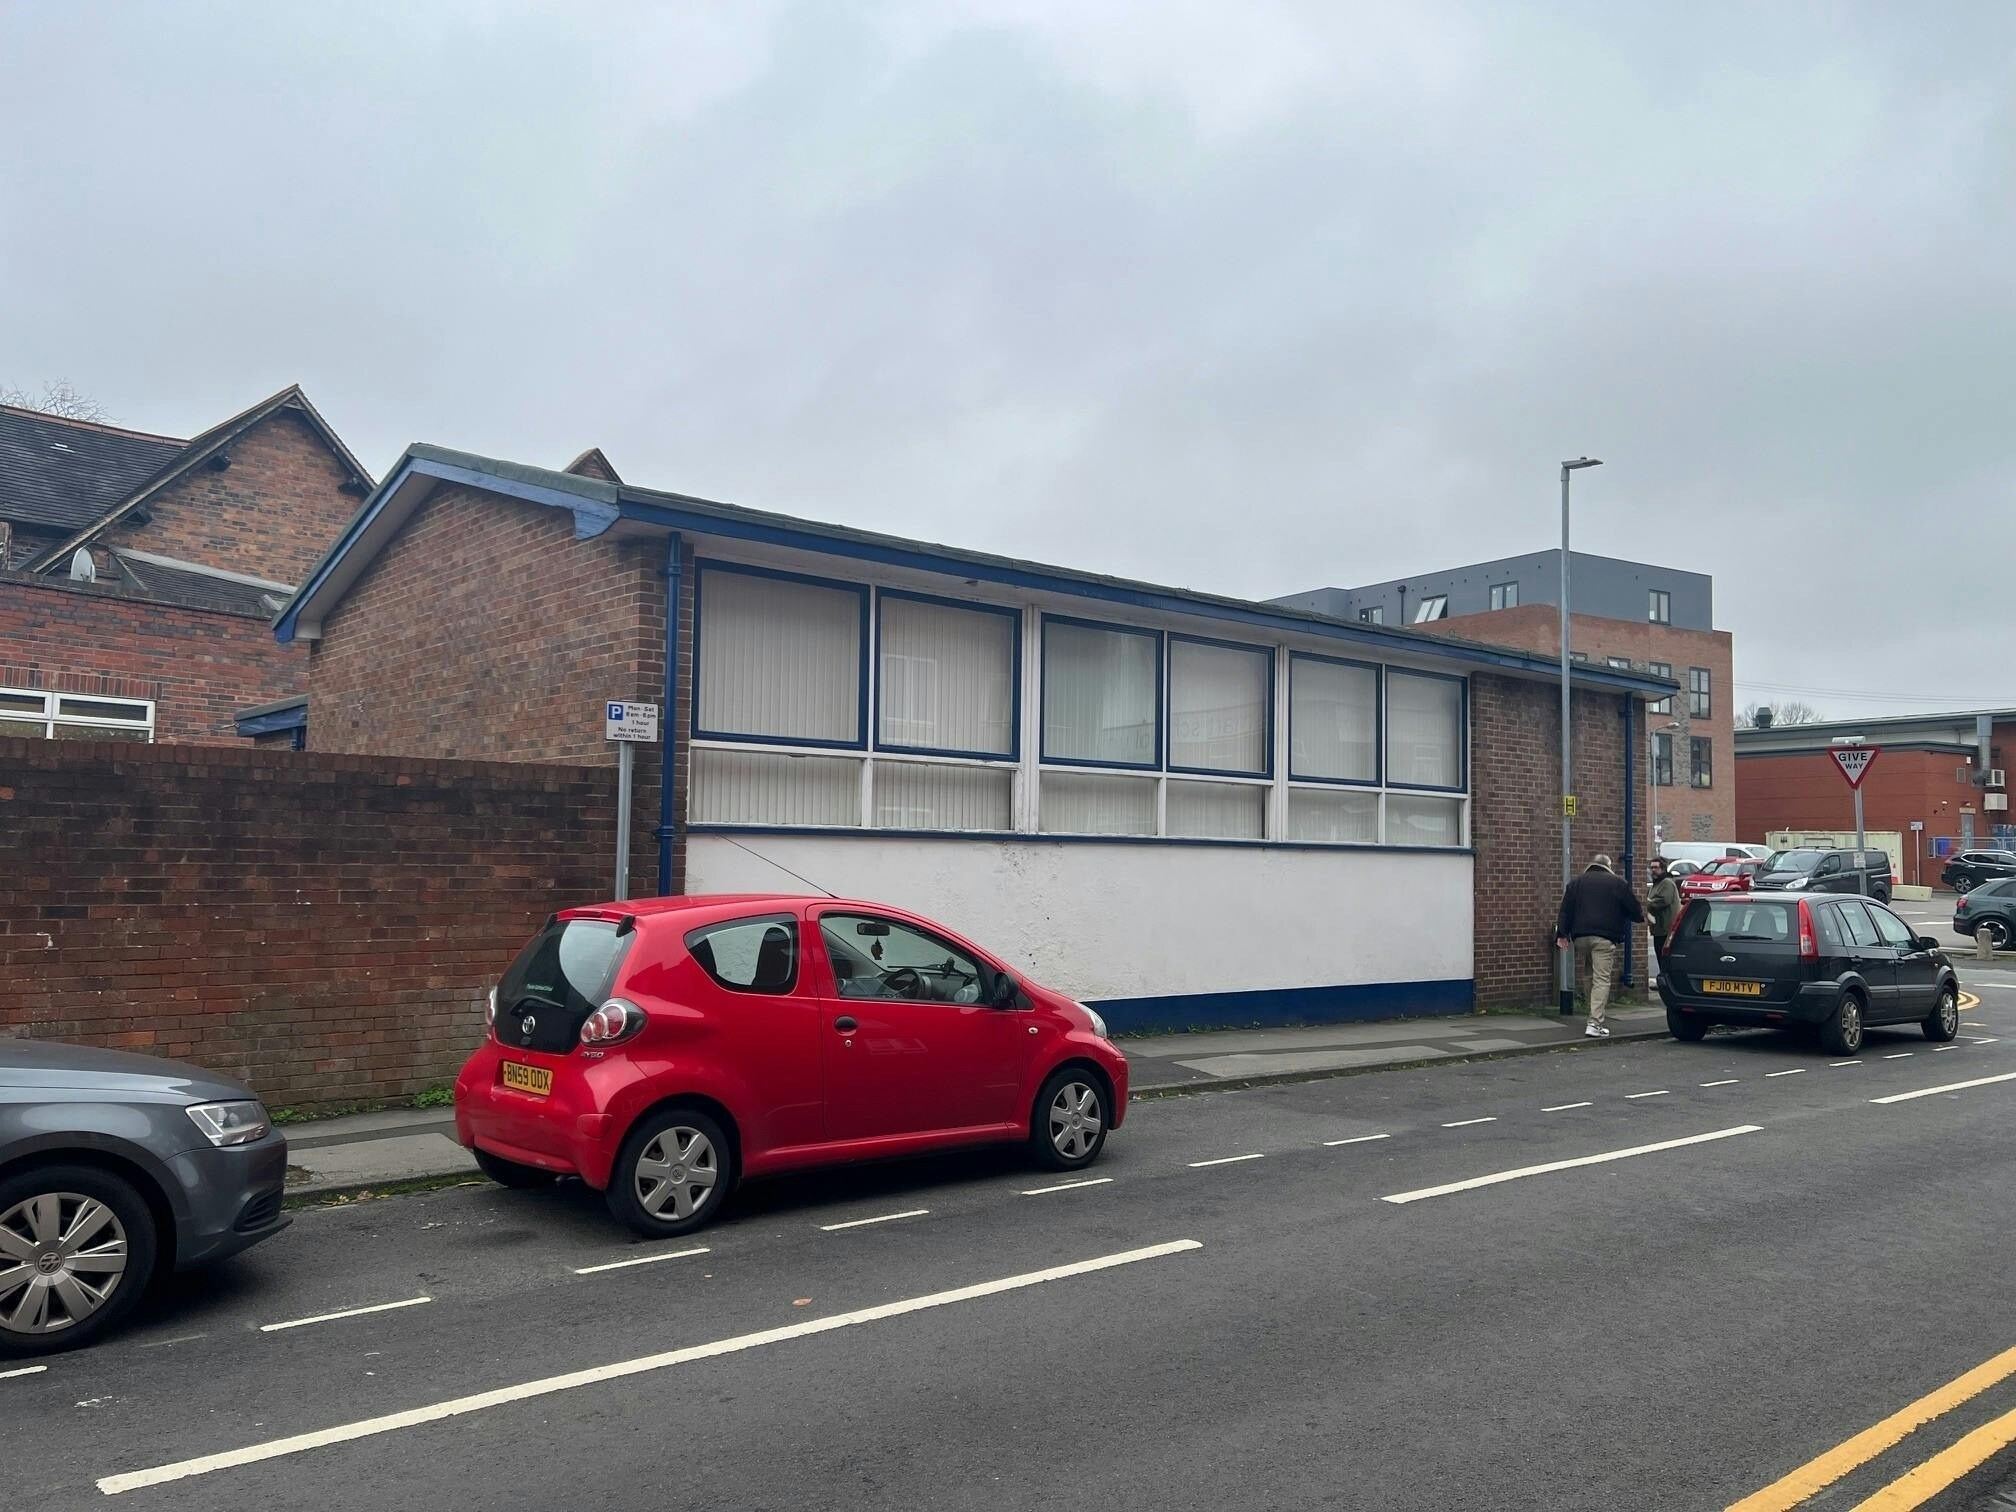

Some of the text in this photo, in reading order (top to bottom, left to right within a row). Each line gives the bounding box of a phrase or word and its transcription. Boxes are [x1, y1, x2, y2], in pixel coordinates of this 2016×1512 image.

[1839, 752, 1867, 761] GIVE
[1710, 981, 1753, 992] FJ10 MTV
[507, 1064, 549, 1090] BN59 ODX
